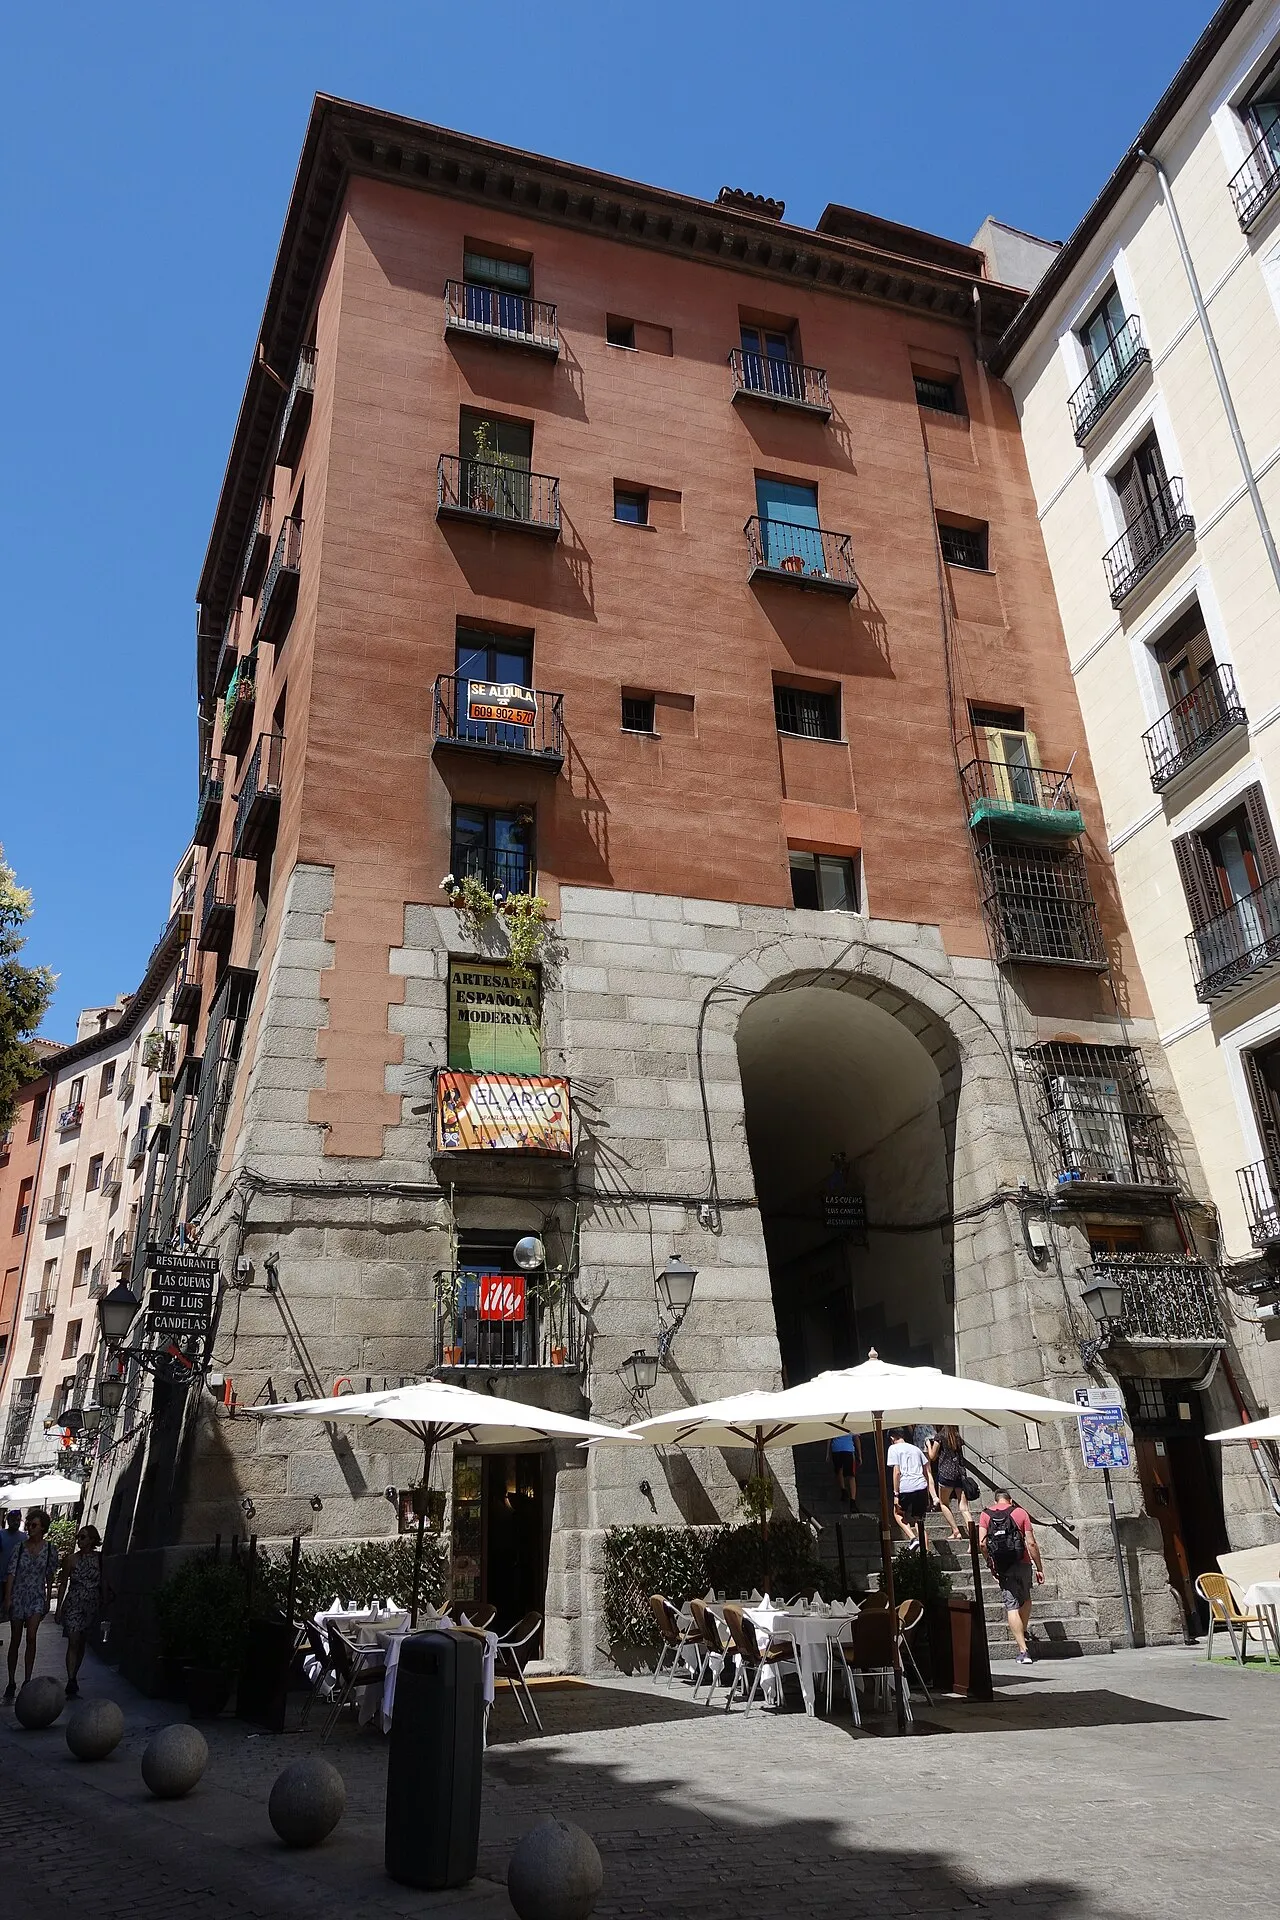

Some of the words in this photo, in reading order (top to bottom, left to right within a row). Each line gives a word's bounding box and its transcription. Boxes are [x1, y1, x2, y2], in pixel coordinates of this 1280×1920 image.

[471, 683, 486, 696] SE
[489, 686, 534, 703] ALQUILA
[474, 705, 493, 718] 609
[496, 708, 513, 720] 902
[516, 710, 533, 724] 570
[456, 990, 535, 1008] ESPAÑOLA
[457, 1009, 532, 1025] MODERNA
[475, 1088, 499, 1106] EL
[507, 1091, 561, 1109] ARCO
[825, 1196, 839, 1204] LAS
[156, 1255, 216, 1270] RESTAURANTE
[159, 1274, 176, 1286] LAS
[178, 1276, 211, 1289] CUEVAS
[161, 1295, 176, 1307] DE
[180, 1297, 204, 1309] LUIS
[483, 1282, 522, 1318] illy
[154, 1316, 207, 1330] CANDELAS
